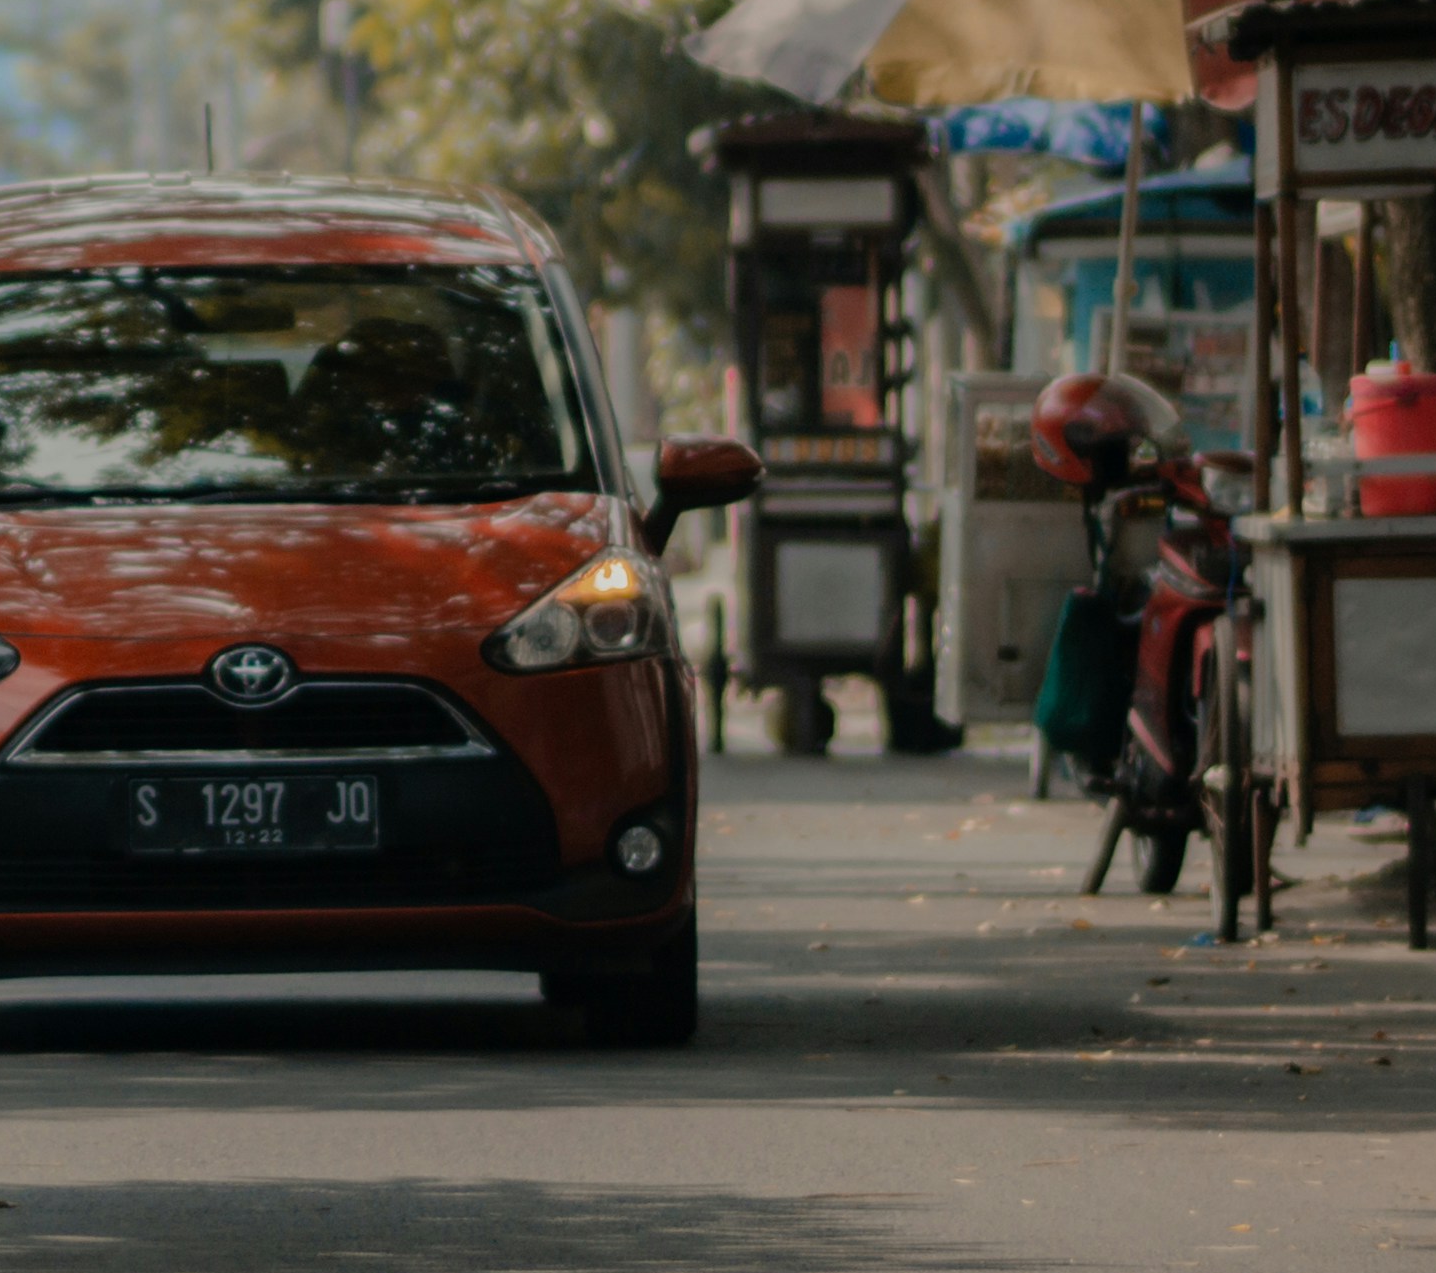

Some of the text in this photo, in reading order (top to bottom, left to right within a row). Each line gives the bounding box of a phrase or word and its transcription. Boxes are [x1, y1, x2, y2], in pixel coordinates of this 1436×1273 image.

[1298, 89, 1350, 145] ES
[136, 780, 370, 827] S 1297 JQ
